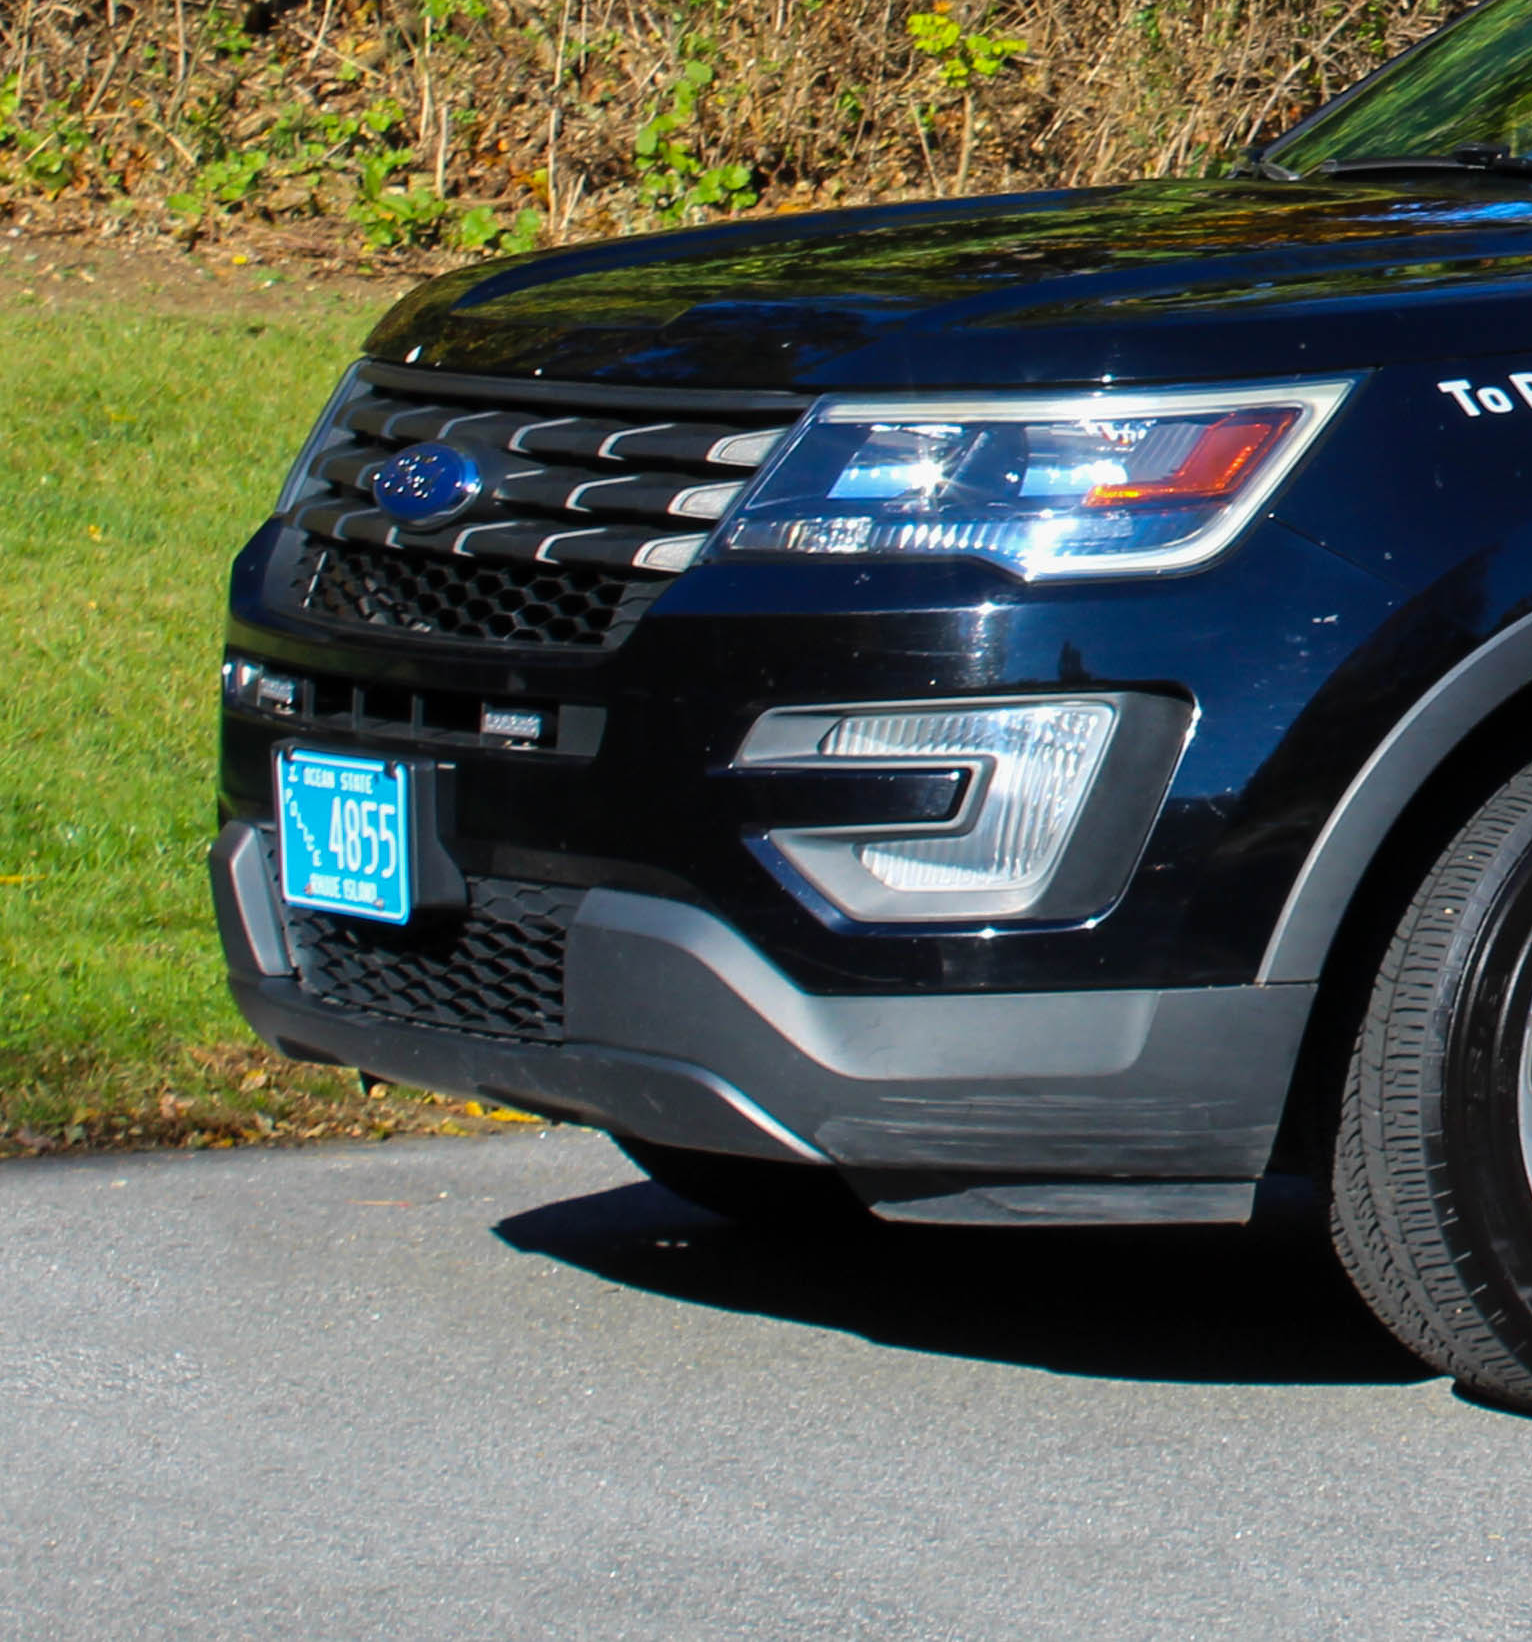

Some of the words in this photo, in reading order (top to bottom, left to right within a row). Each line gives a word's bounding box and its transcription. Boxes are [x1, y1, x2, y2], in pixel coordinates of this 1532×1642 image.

[1437, 379, 1512, 416] To
[303, 766, 336, 789] OCEAN
[340, 771, 374, 795] STATE
[328, 795, 397, 879] 4855
